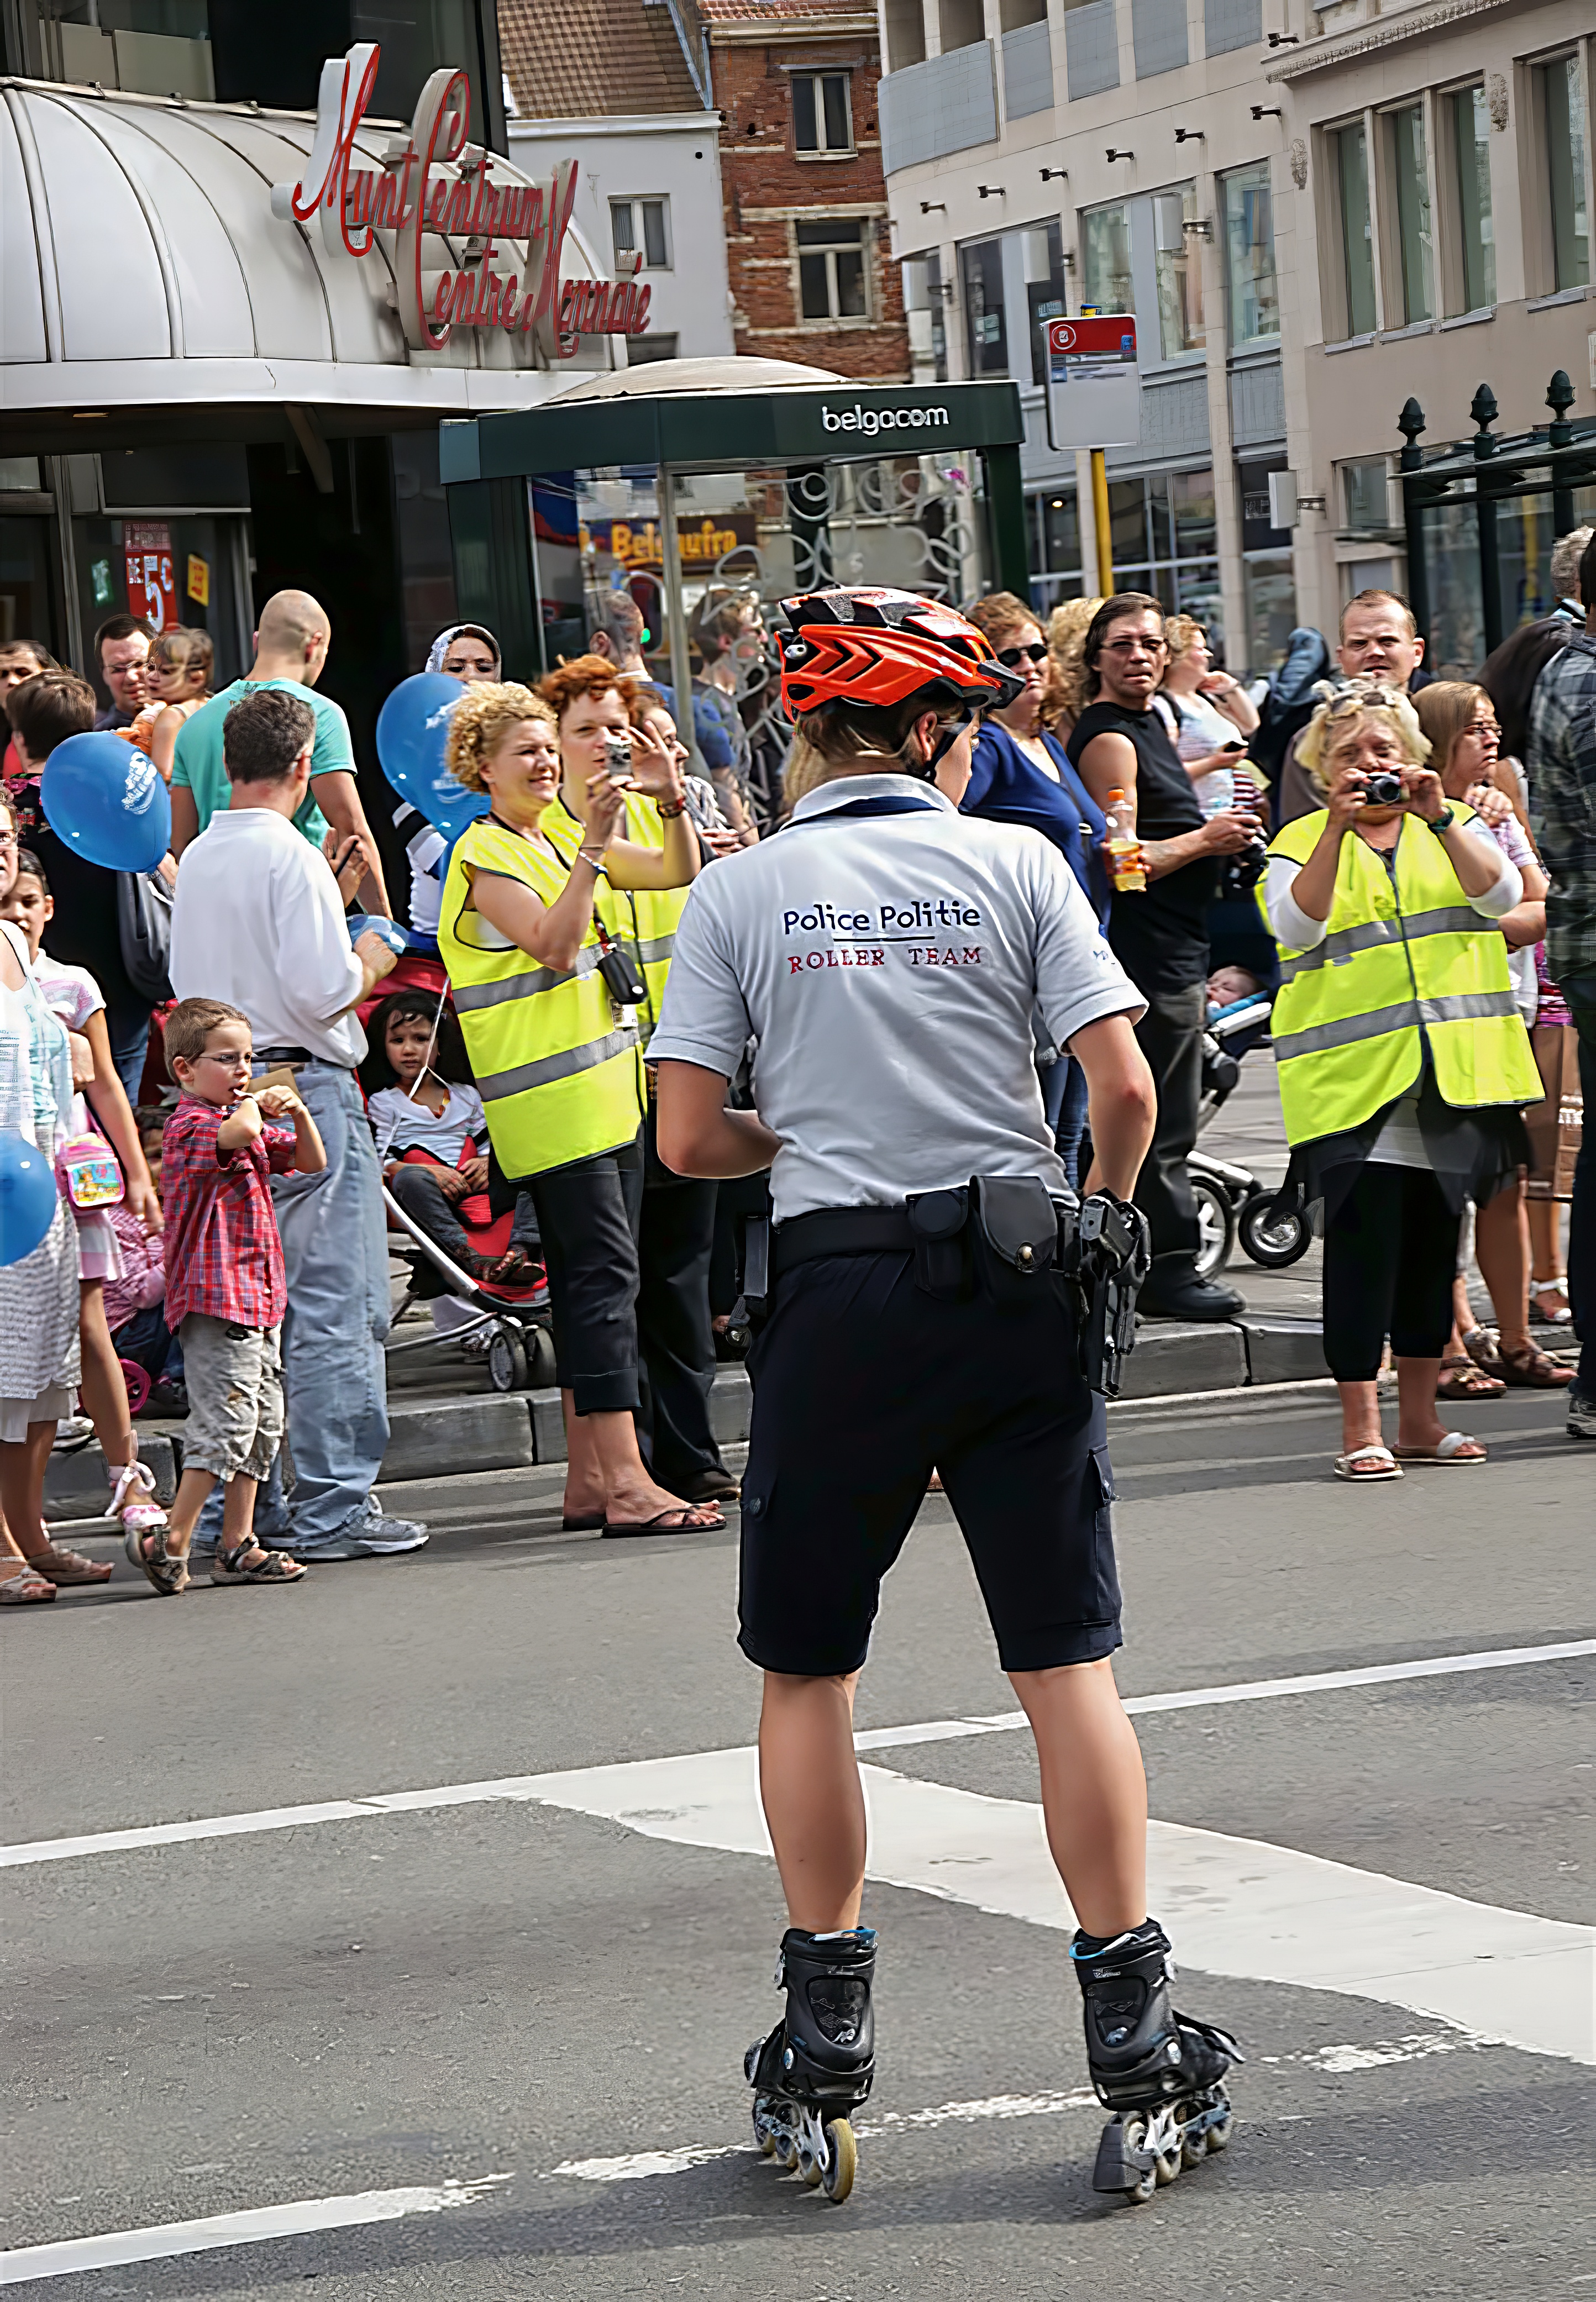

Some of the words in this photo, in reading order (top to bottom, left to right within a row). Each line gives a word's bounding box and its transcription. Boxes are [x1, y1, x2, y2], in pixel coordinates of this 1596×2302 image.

[784, 903, 870, 935] Police
[880, 900, 981, 929] Politie
[787, 948, 885, 974] ROLLER
[908, 947, 981, 965] TEAM
